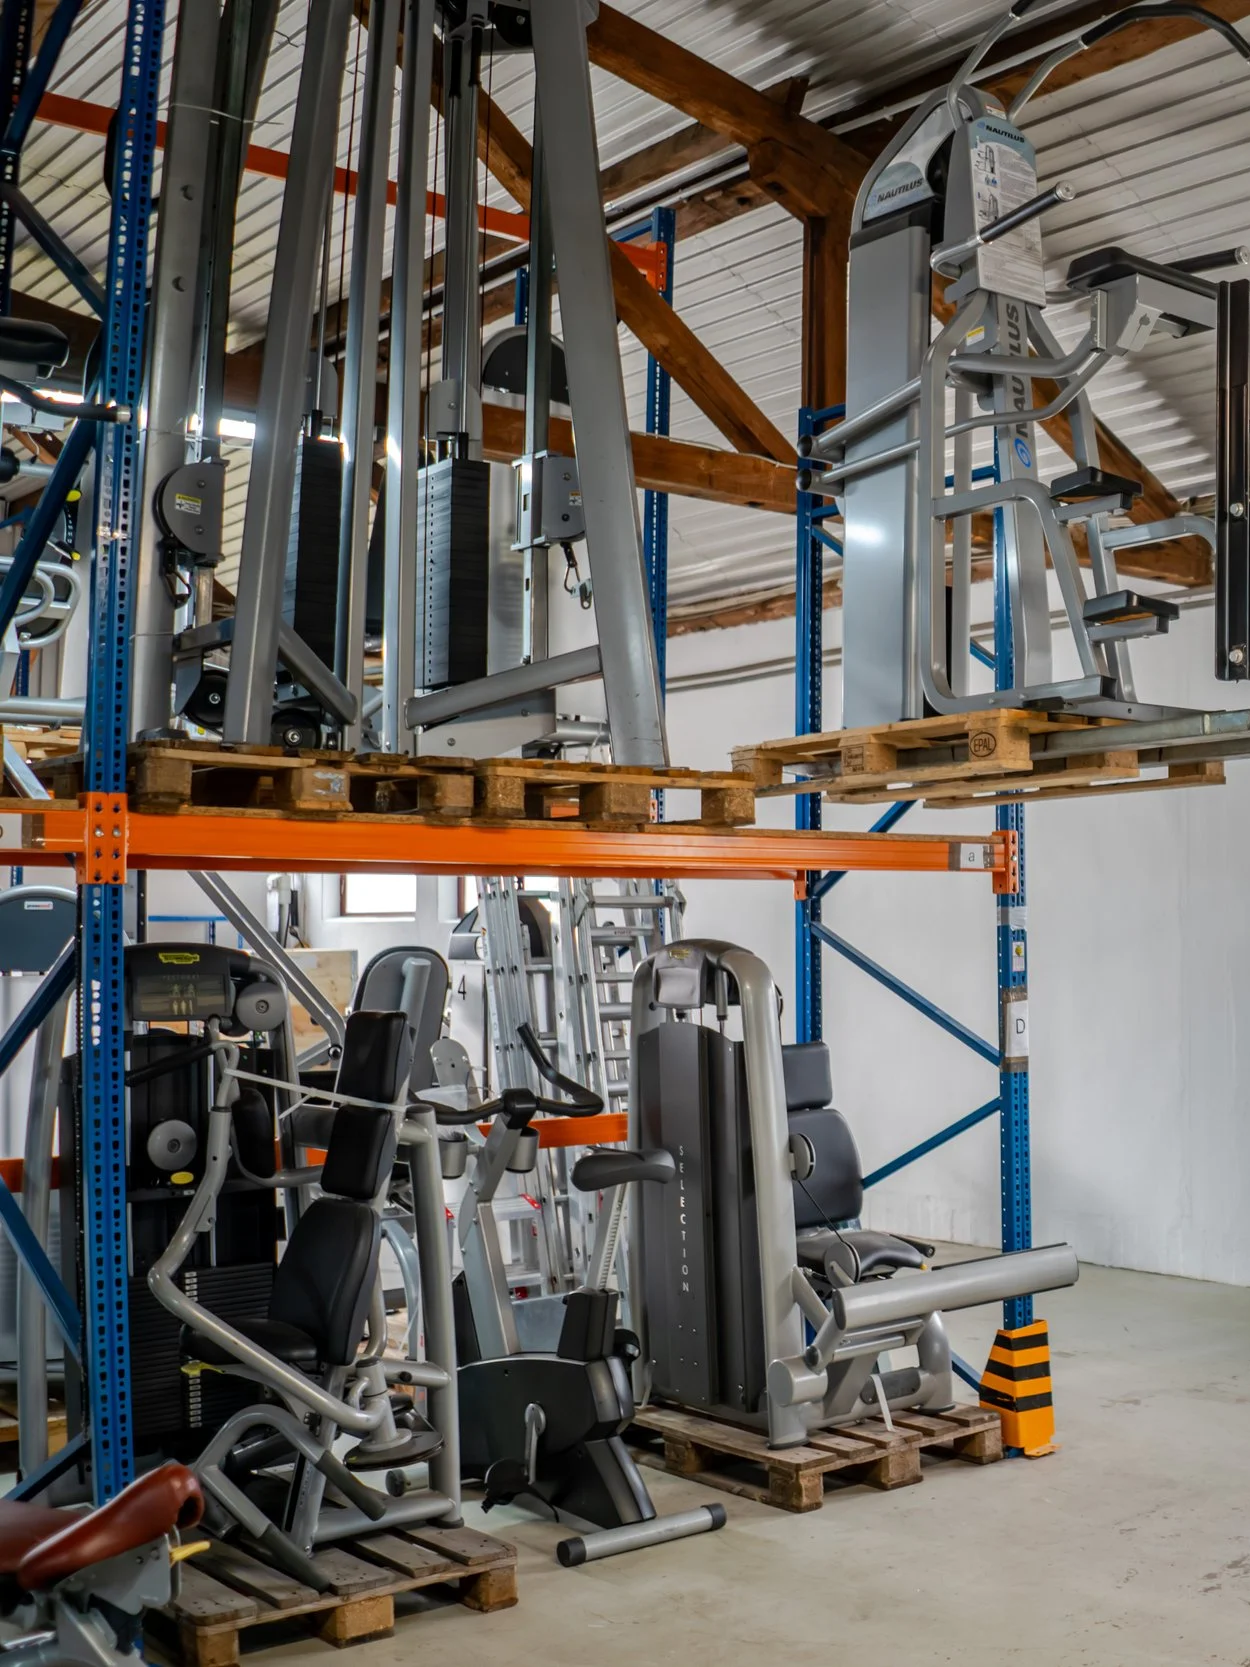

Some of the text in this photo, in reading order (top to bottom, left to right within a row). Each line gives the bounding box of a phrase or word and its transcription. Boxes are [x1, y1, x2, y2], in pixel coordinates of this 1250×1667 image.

[986, 124, 1025, 143] NAUTILUS
[877, 177, 924, 202] NAUTILUS
[1006, 303, 1028, 438] NAULUS
[974, 737, 992, 752] EPAL
[457, 974, 467, 1000] 4
[1015, 1018, 1026, 1034] D
[679, 1145, 689, 1292] SELECTION
